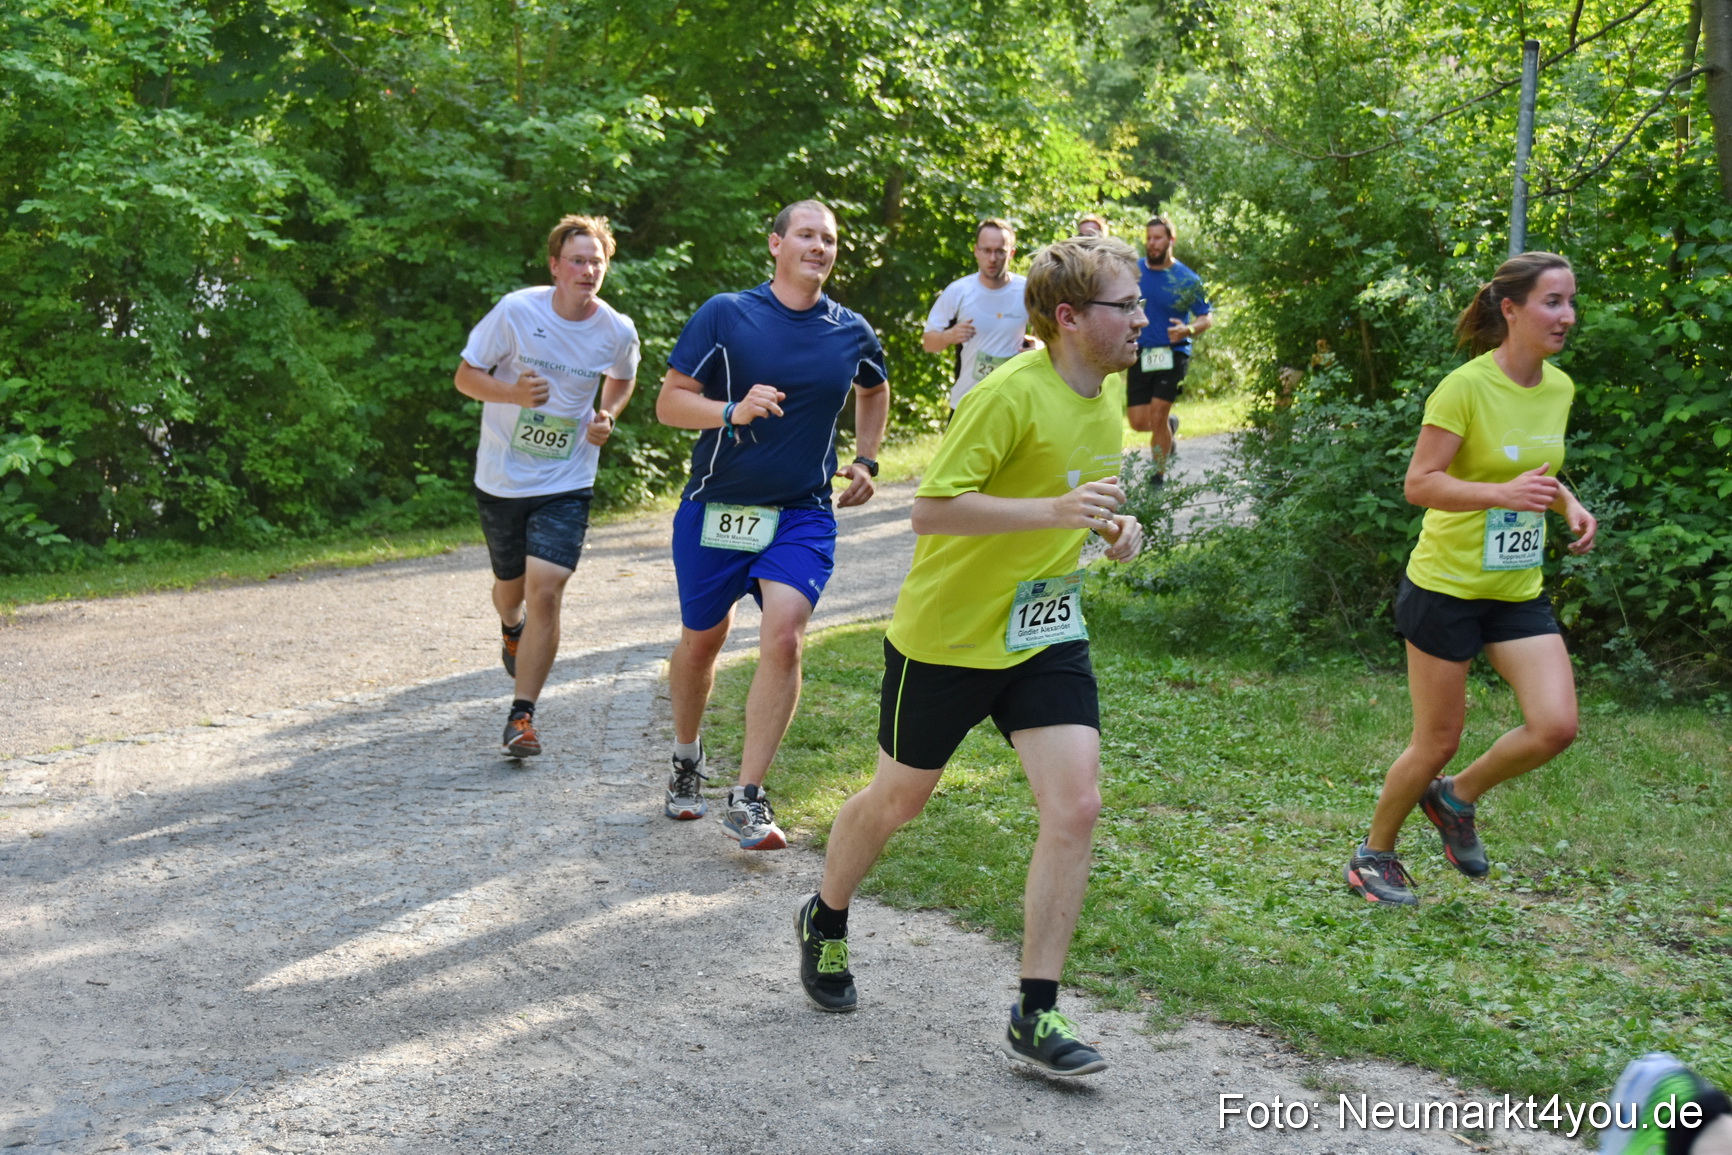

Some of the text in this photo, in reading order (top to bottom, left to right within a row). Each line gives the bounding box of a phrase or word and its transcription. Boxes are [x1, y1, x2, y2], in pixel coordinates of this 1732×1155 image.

[520, 425, 569, 448] 2095
[719, 513, 760, 535] 817
[1495, 529, 1540, 553] 1282
[1018, 595, 1071, 628] 1225
[1018, 623, 1071, 637] Gindler Alexander
